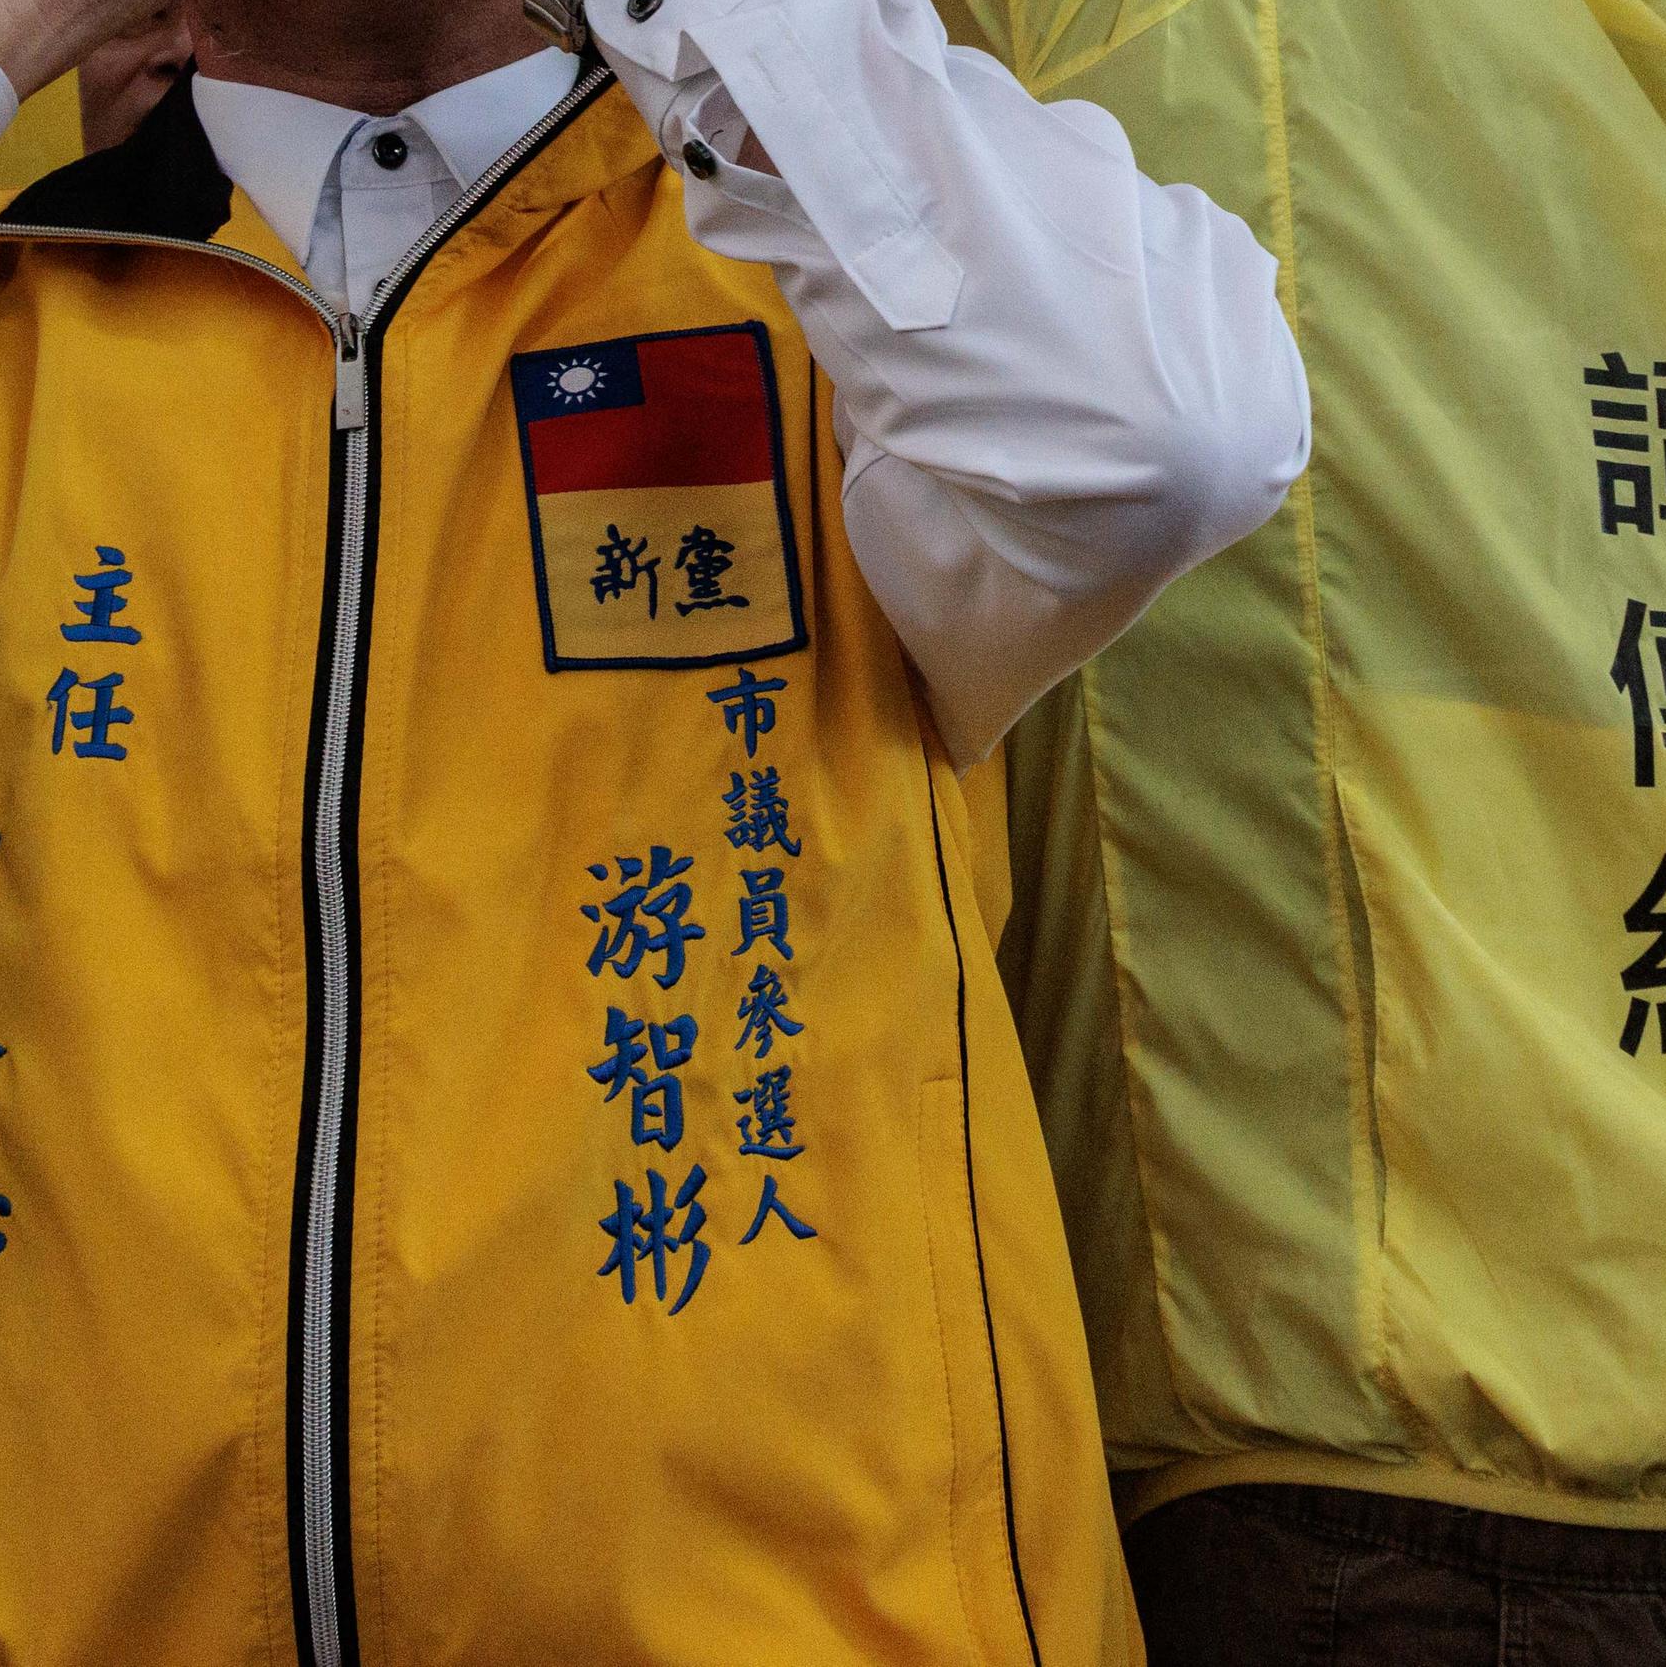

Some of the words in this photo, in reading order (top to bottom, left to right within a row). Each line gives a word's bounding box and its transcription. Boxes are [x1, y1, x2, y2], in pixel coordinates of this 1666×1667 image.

[45, 545, 143, 761] 主任
[589, 523, 751, 621] 新黨
[583, 845, 711, 1316] 游智彬
[706, 667, 819, 1247] 市議員參選人
